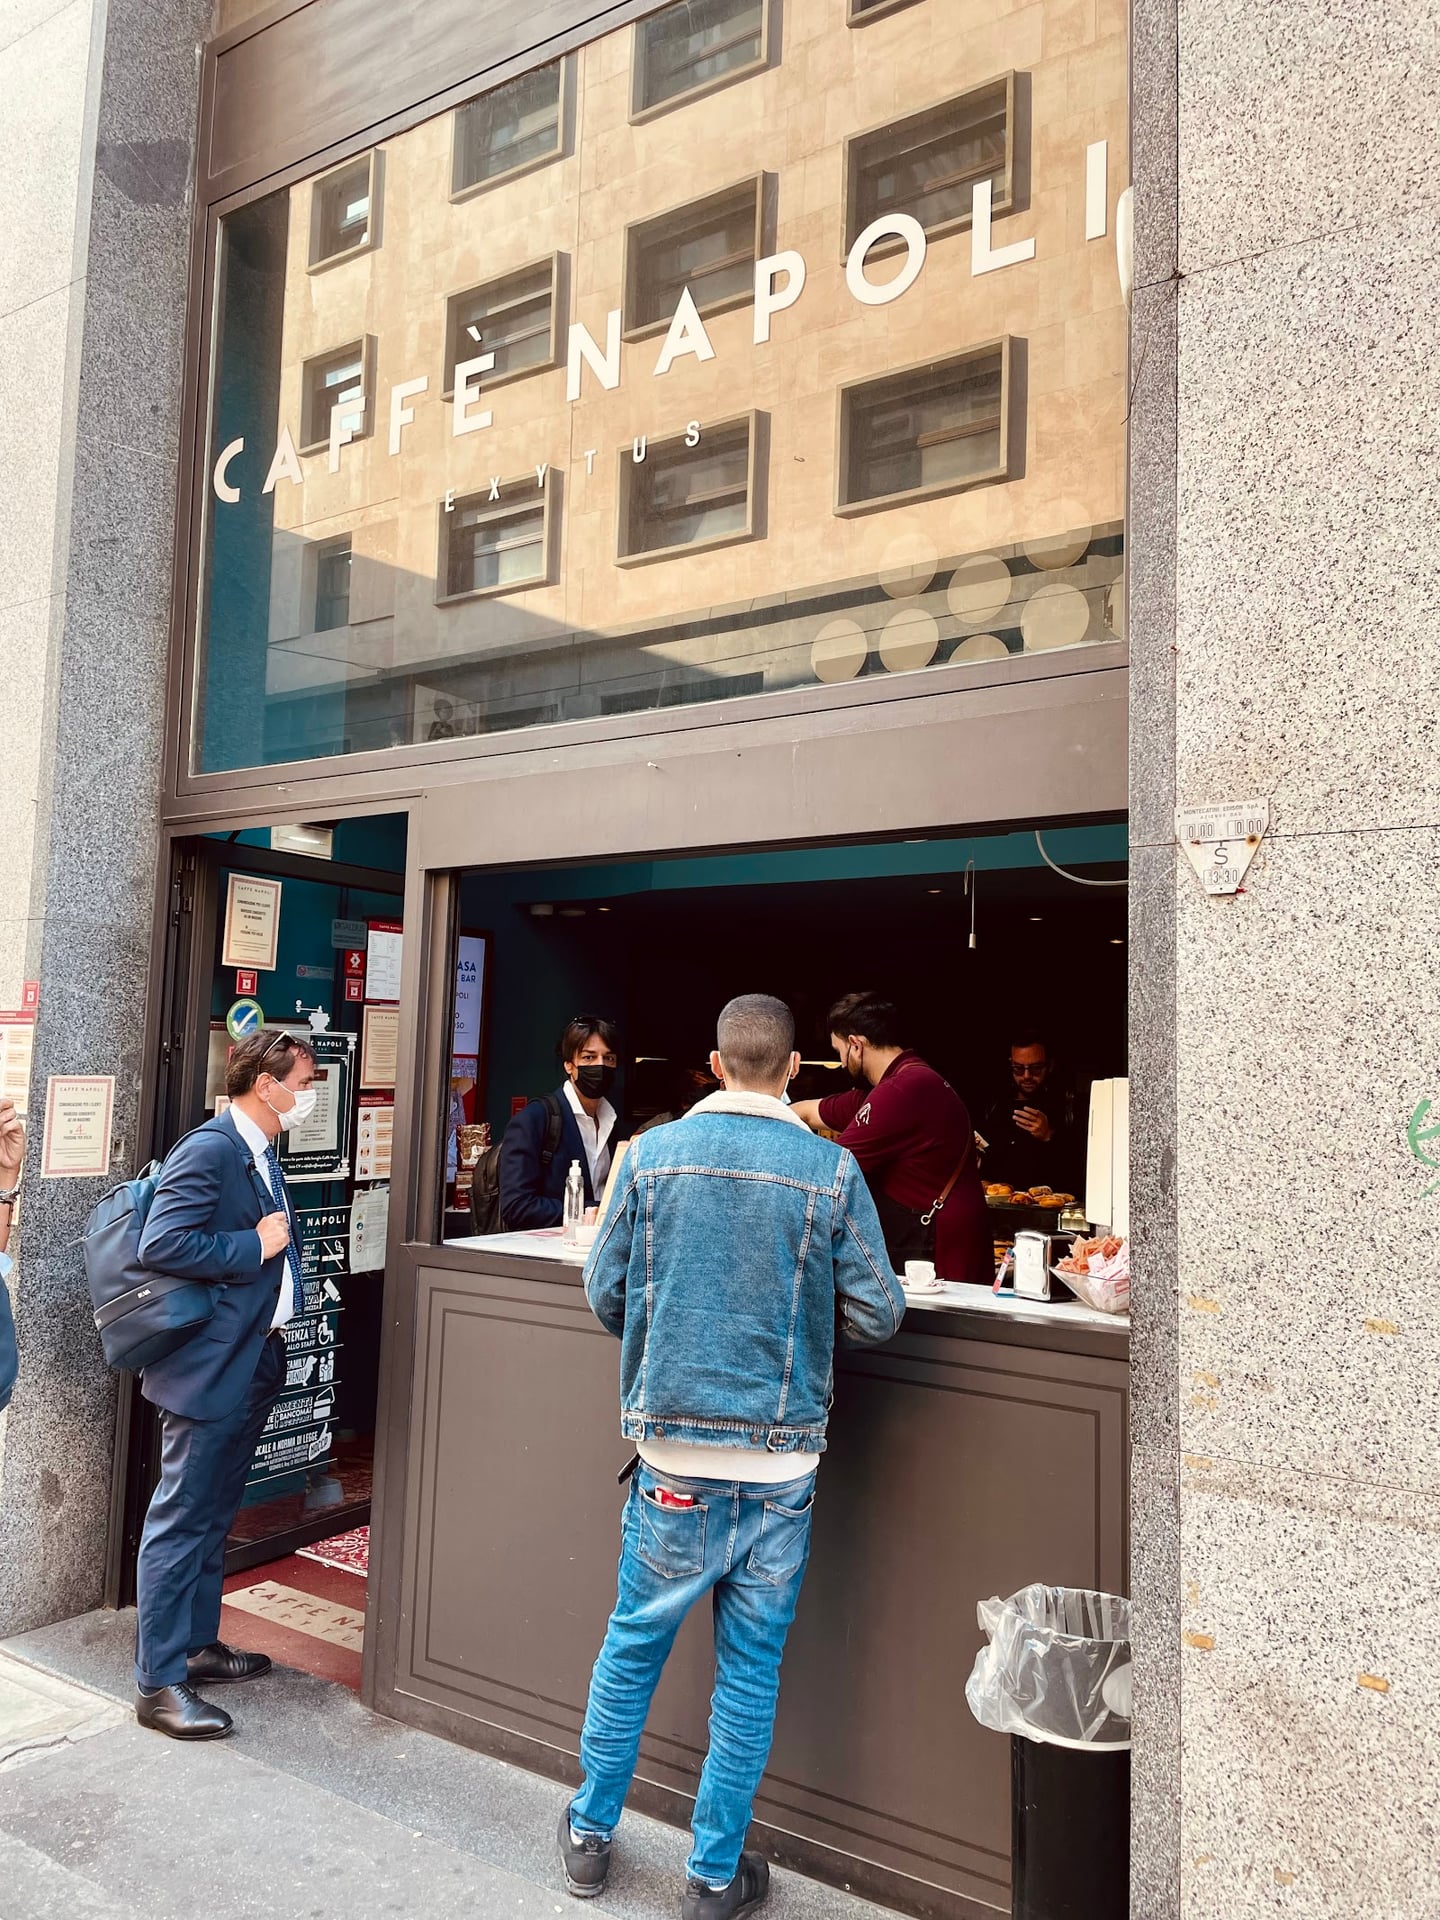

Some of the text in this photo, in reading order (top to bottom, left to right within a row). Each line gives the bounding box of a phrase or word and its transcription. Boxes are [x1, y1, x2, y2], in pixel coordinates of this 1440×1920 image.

[213, 139, 1108, 503] CAFFÈ NAPOLI
[444, 419, 701, 513] EXYTUS
[1184, 807, 1219, 815] MONTECATINI
[1214, 847, 1228, 865] S
[461, 974, 476, 983] BAR
[306, 1214, 346, 1227] NAPOLI
[286, 1339, 316, 1351] ALLO STAFF
[277, 1436, 296, 1451] NORMA
[296, 1435, 303, 1446] DI
[302, 1430, 319, 1444] LEGGE
